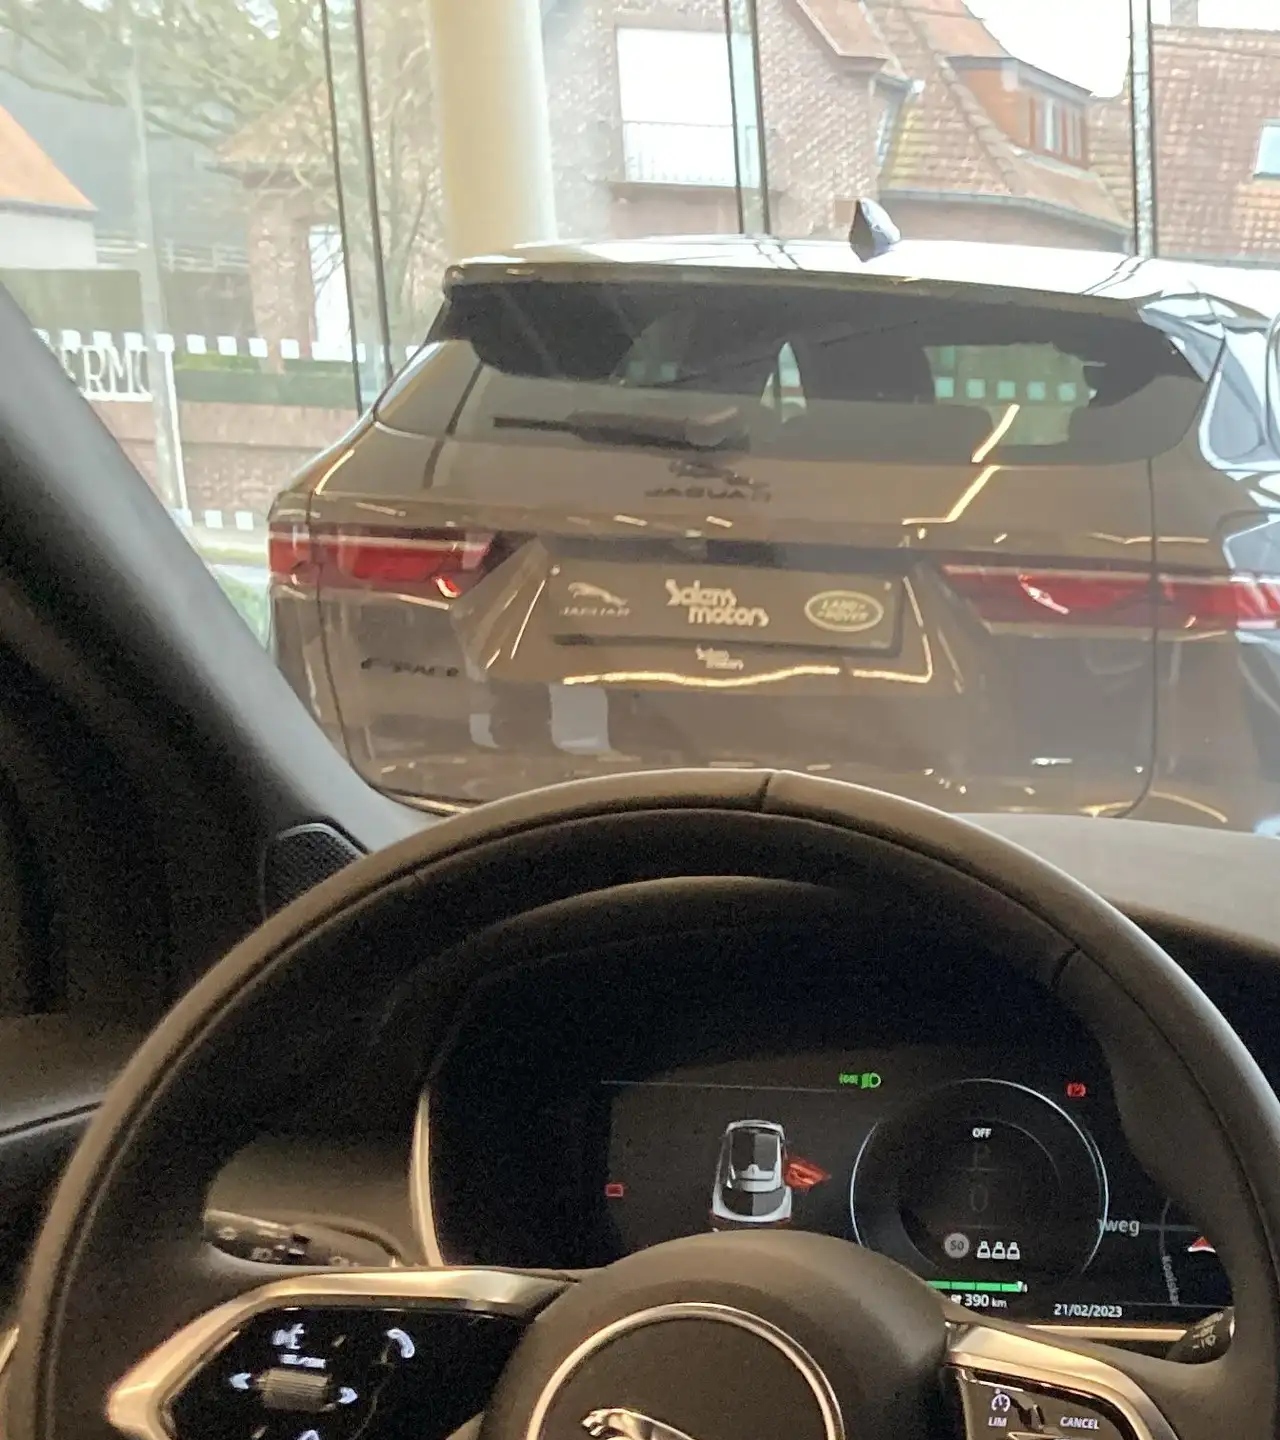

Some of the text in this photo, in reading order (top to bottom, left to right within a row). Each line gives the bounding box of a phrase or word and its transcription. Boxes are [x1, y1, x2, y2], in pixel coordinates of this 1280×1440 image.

[972, 1128, 992, 1138] OFF
[965, 1294, 1007, 1308] 390 km
[1054, 1303, 1122, 1318] 21/02/2023
[988, 1417, 1007, 1427] LIM
[1060, 1416, 1099, 1429] CANCEL
